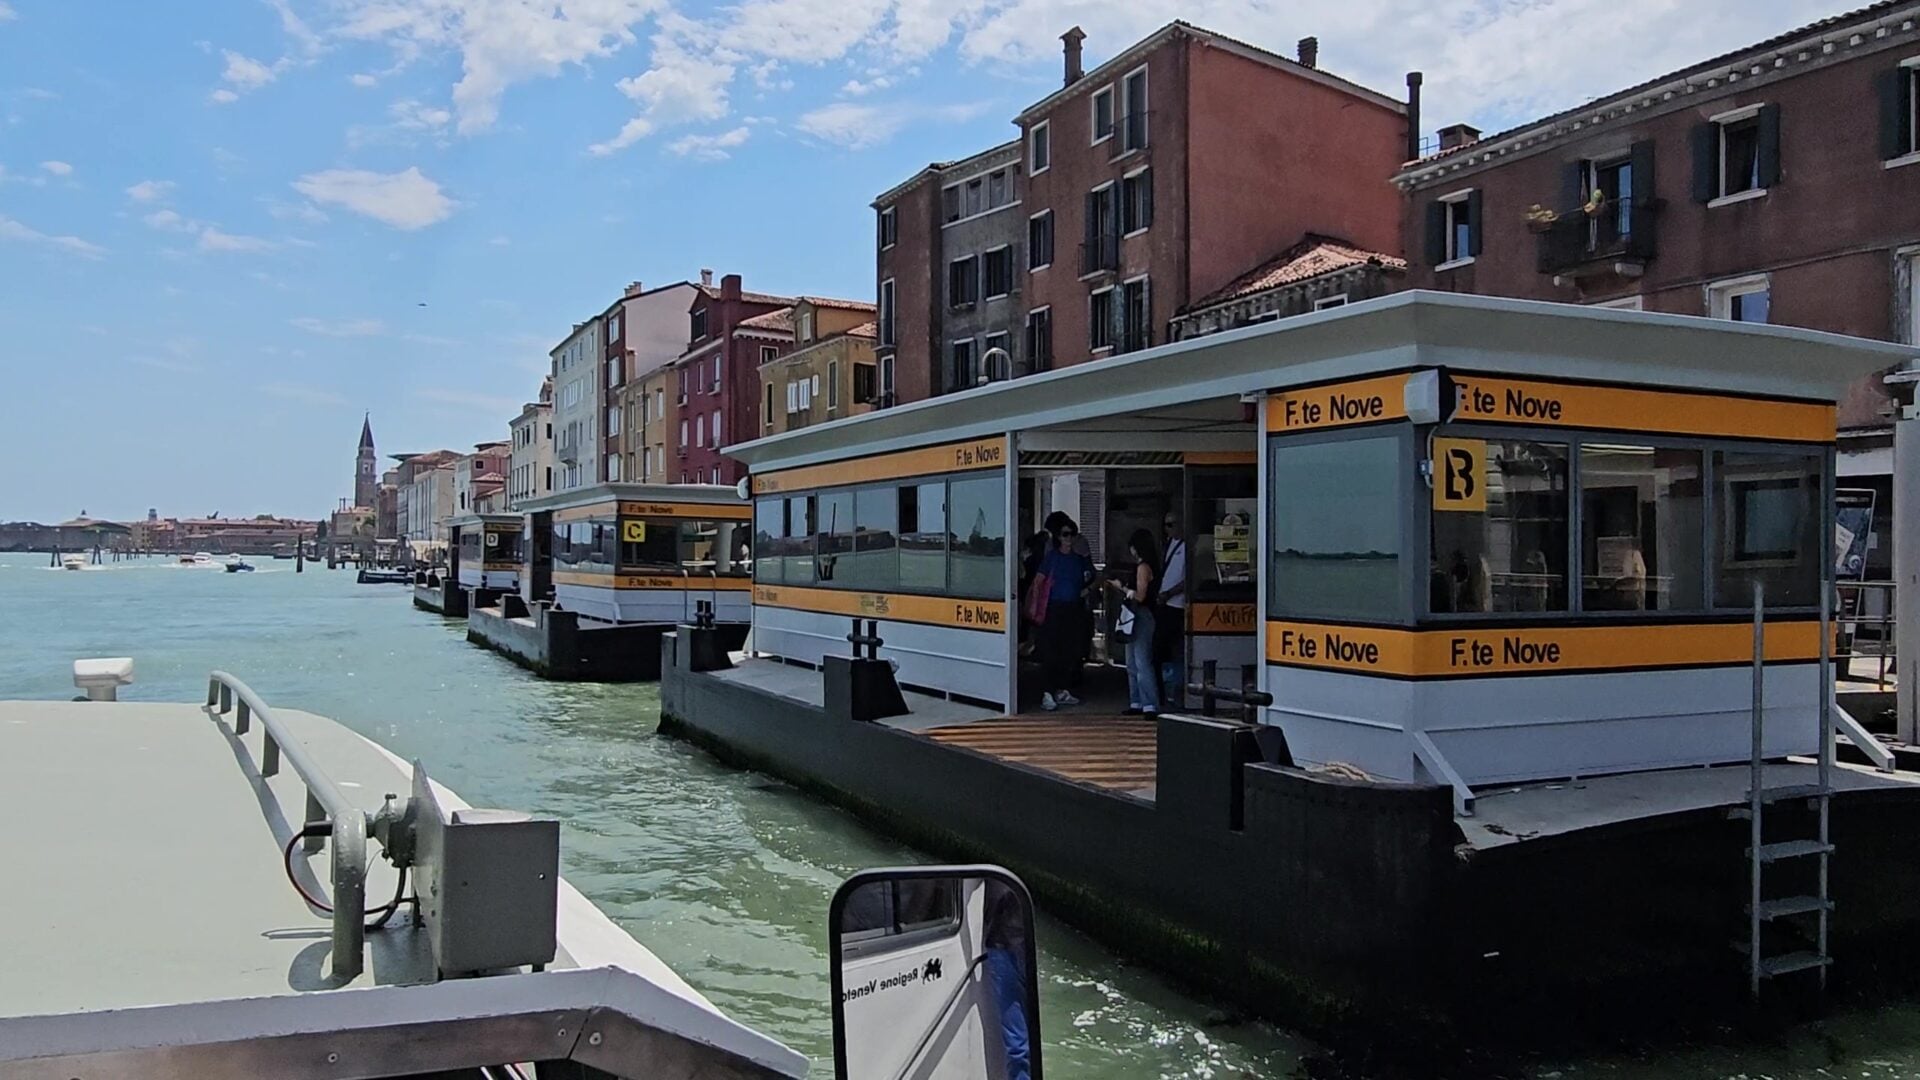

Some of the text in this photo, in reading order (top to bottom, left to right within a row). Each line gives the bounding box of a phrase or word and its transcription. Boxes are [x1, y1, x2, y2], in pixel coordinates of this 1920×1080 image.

[1285, 394, 1384, 426] F.te Nove
[1505, 388, 1561, 420] Nove
[956, 445, 1000, 466] F.te Nove
[1445, 448, 1475, 500] B
[628, 523, 642, 540] C
[956, 604, 1000, 625] F.te Nove
[1281, 630, 1379, 664] F.te Nove
[1451, 637, 1561, 667] F.te Nove
